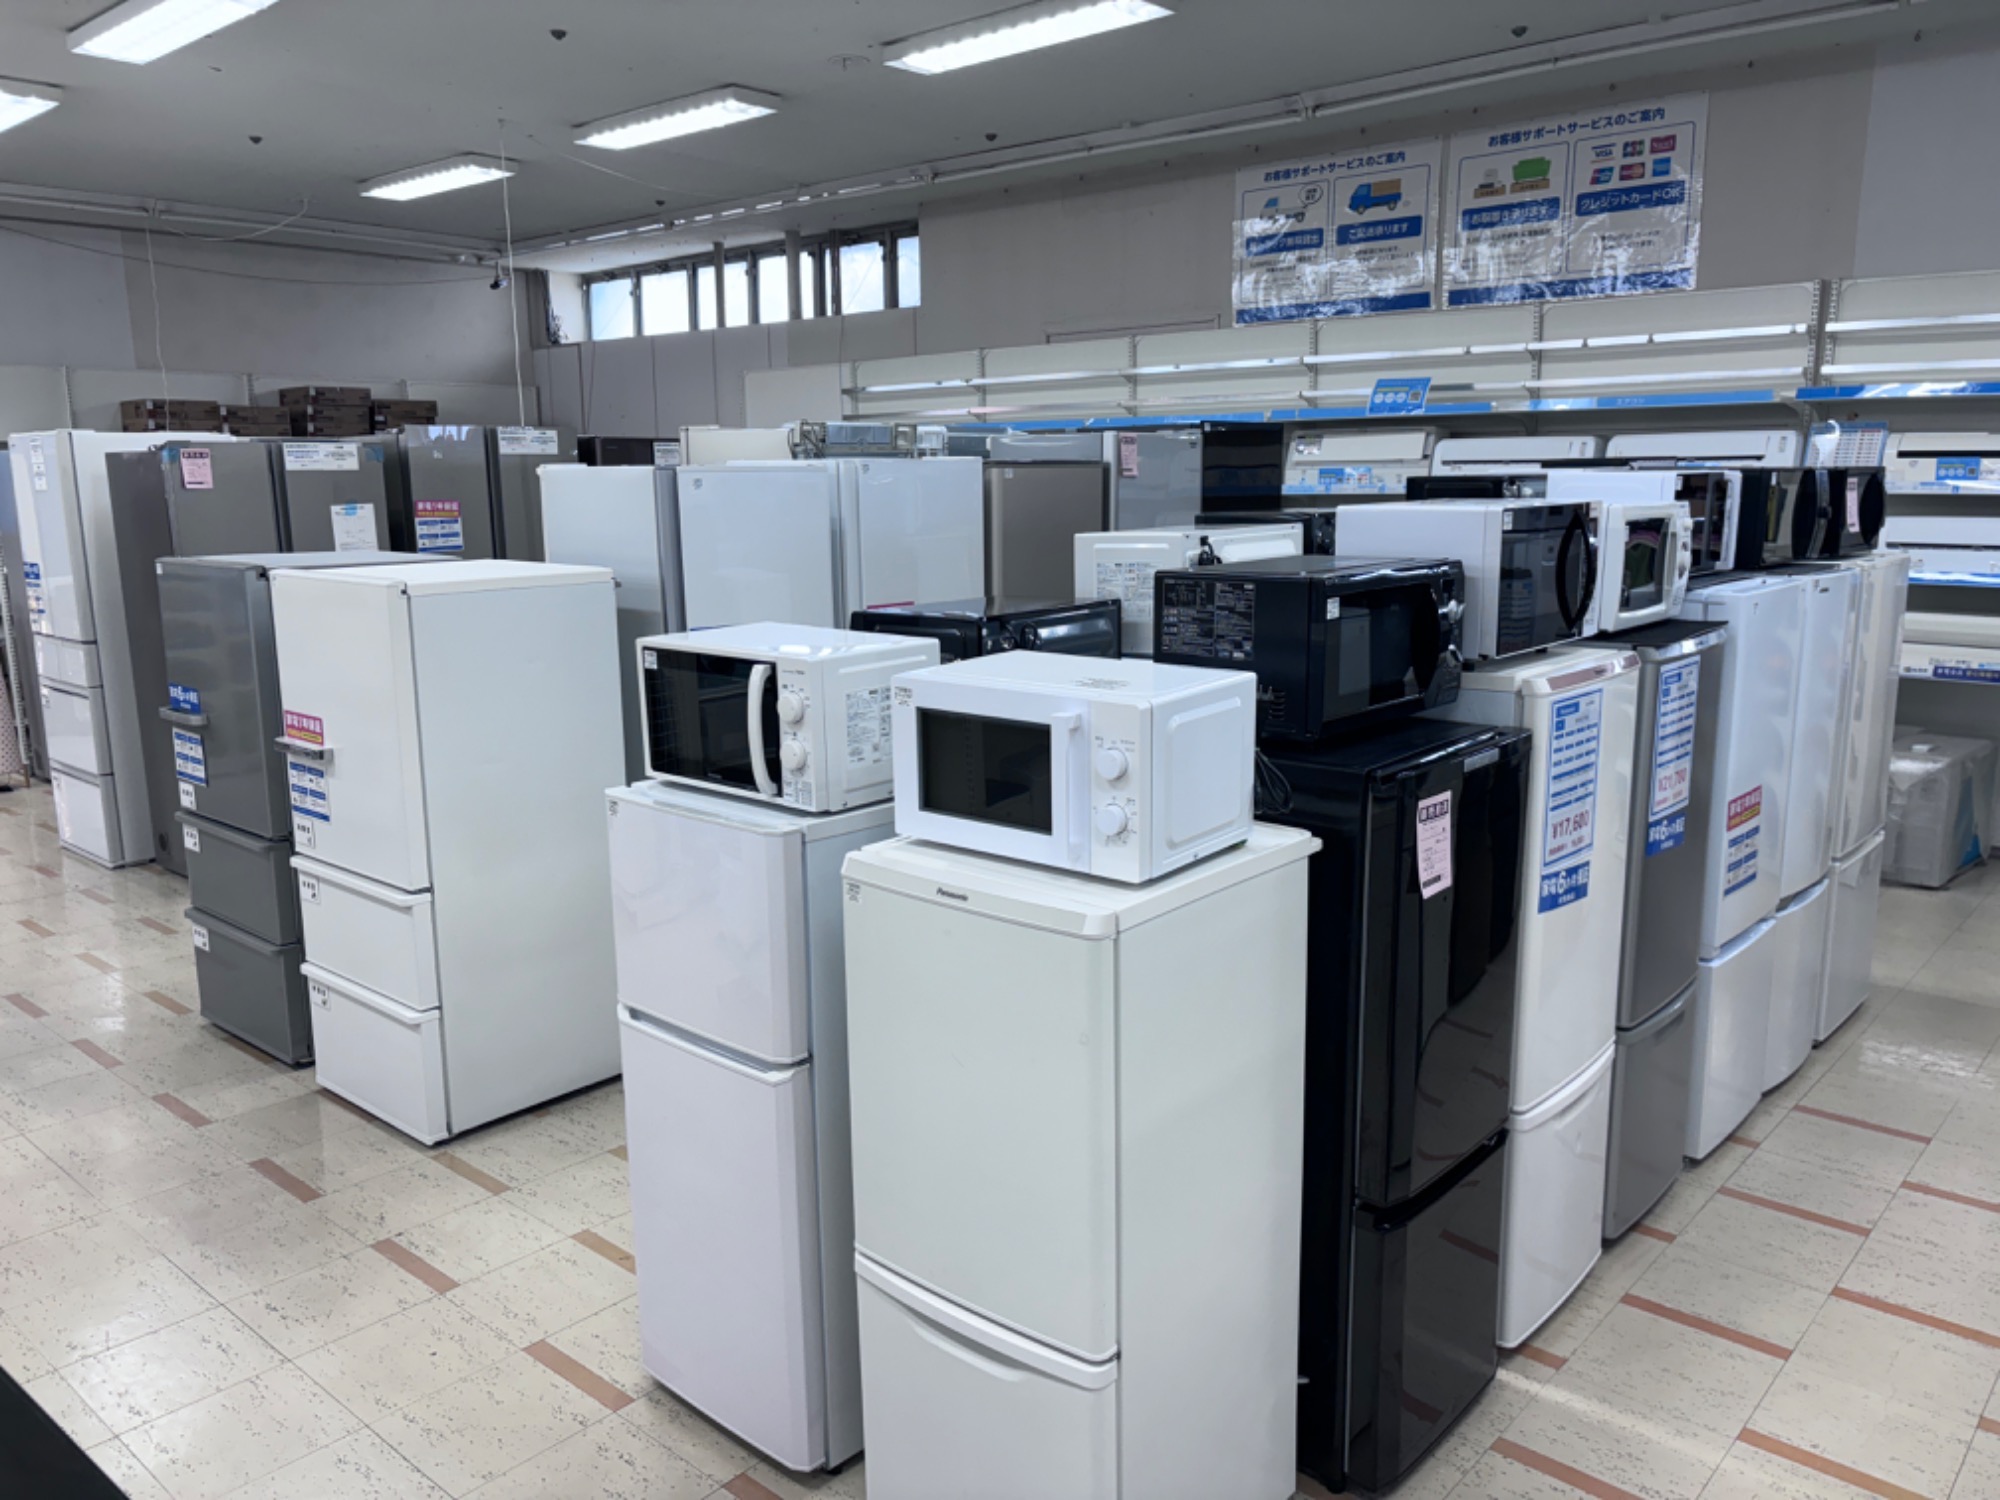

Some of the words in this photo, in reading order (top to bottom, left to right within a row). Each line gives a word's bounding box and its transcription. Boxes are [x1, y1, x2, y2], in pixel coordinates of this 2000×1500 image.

[1487, 106, 1666, 148] お客様サポートサービスのご案内
[1594, 147, 1613, 158] VISA
[1263, 151, 1406, 182] お客様サポートサービスのご案内
[1580, 187, 1681, 211] クレジットカードOK
[936, 886, 969, 902] Panasonic
